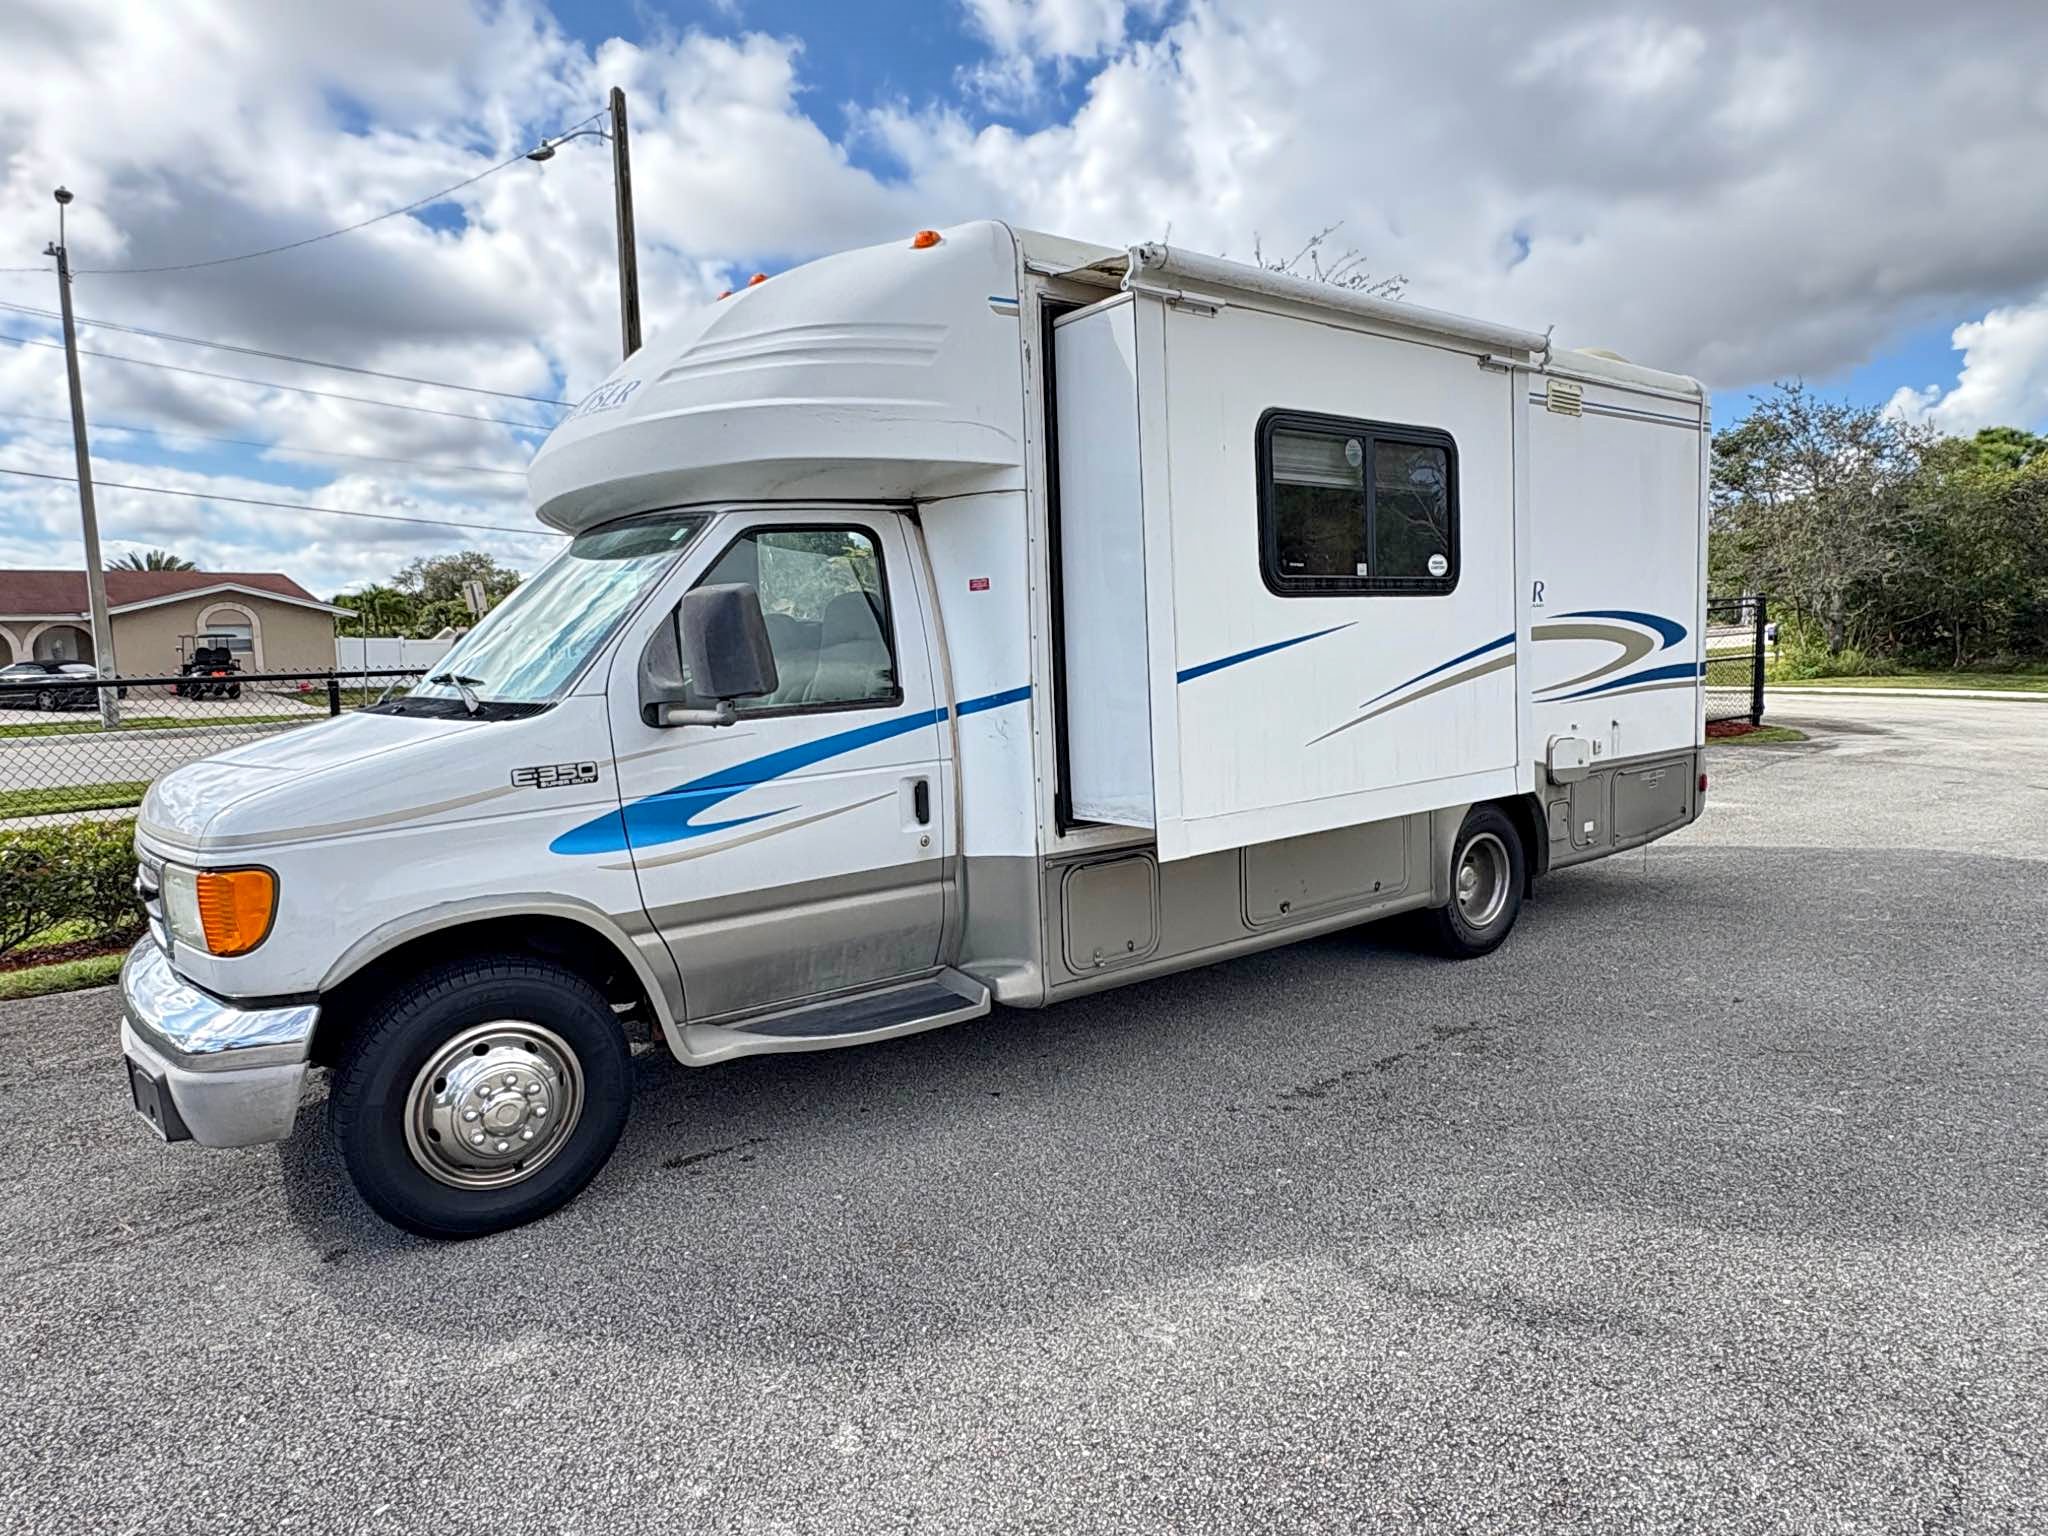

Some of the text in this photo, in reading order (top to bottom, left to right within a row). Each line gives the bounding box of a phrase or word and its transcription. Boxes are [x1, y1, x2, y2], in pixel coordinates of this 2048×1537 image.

[1532, 580, 1544, 602] R
[540, 776, 595, 788] SUPER DUTY
